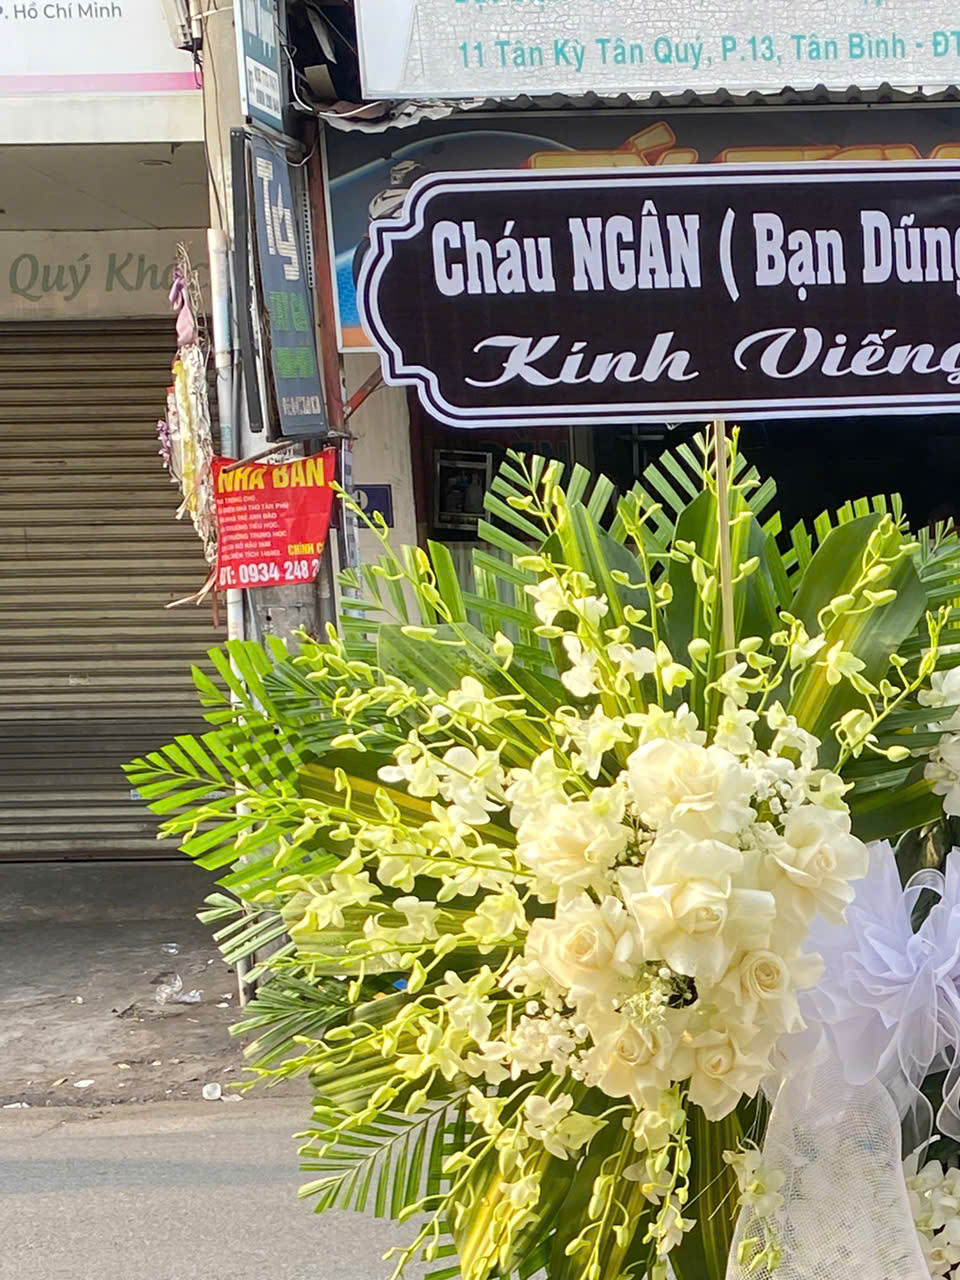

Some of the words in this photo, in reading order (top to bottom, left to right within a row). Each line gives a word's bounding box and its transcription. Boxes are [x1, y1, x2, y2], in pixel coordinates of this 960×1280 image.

[14, 1, 38, 19] Hồ
[43, 2, 72, 19] Chí
[78, 2, 122, 19] Minh
[459, 41, 484, 68] 11
[495, 40, 544, 67] Tân
[553, 38, 586, 72] Kỳ
[595, 38, 645, 65] Tân
[791, 34, 839, 61] Tân
[848, 32, 906, 60] Bình
[431, 220, 557, 297] Cháu
[568, 199, 702, 292] NGÂN
[752, 212, 847, 302] Bạn
[9, 253, 91, 301] Quý
[464, 331, 700, 388] Kính
[239, 562, 281, 583] 0934
[283, 559, 310, 581] 248
